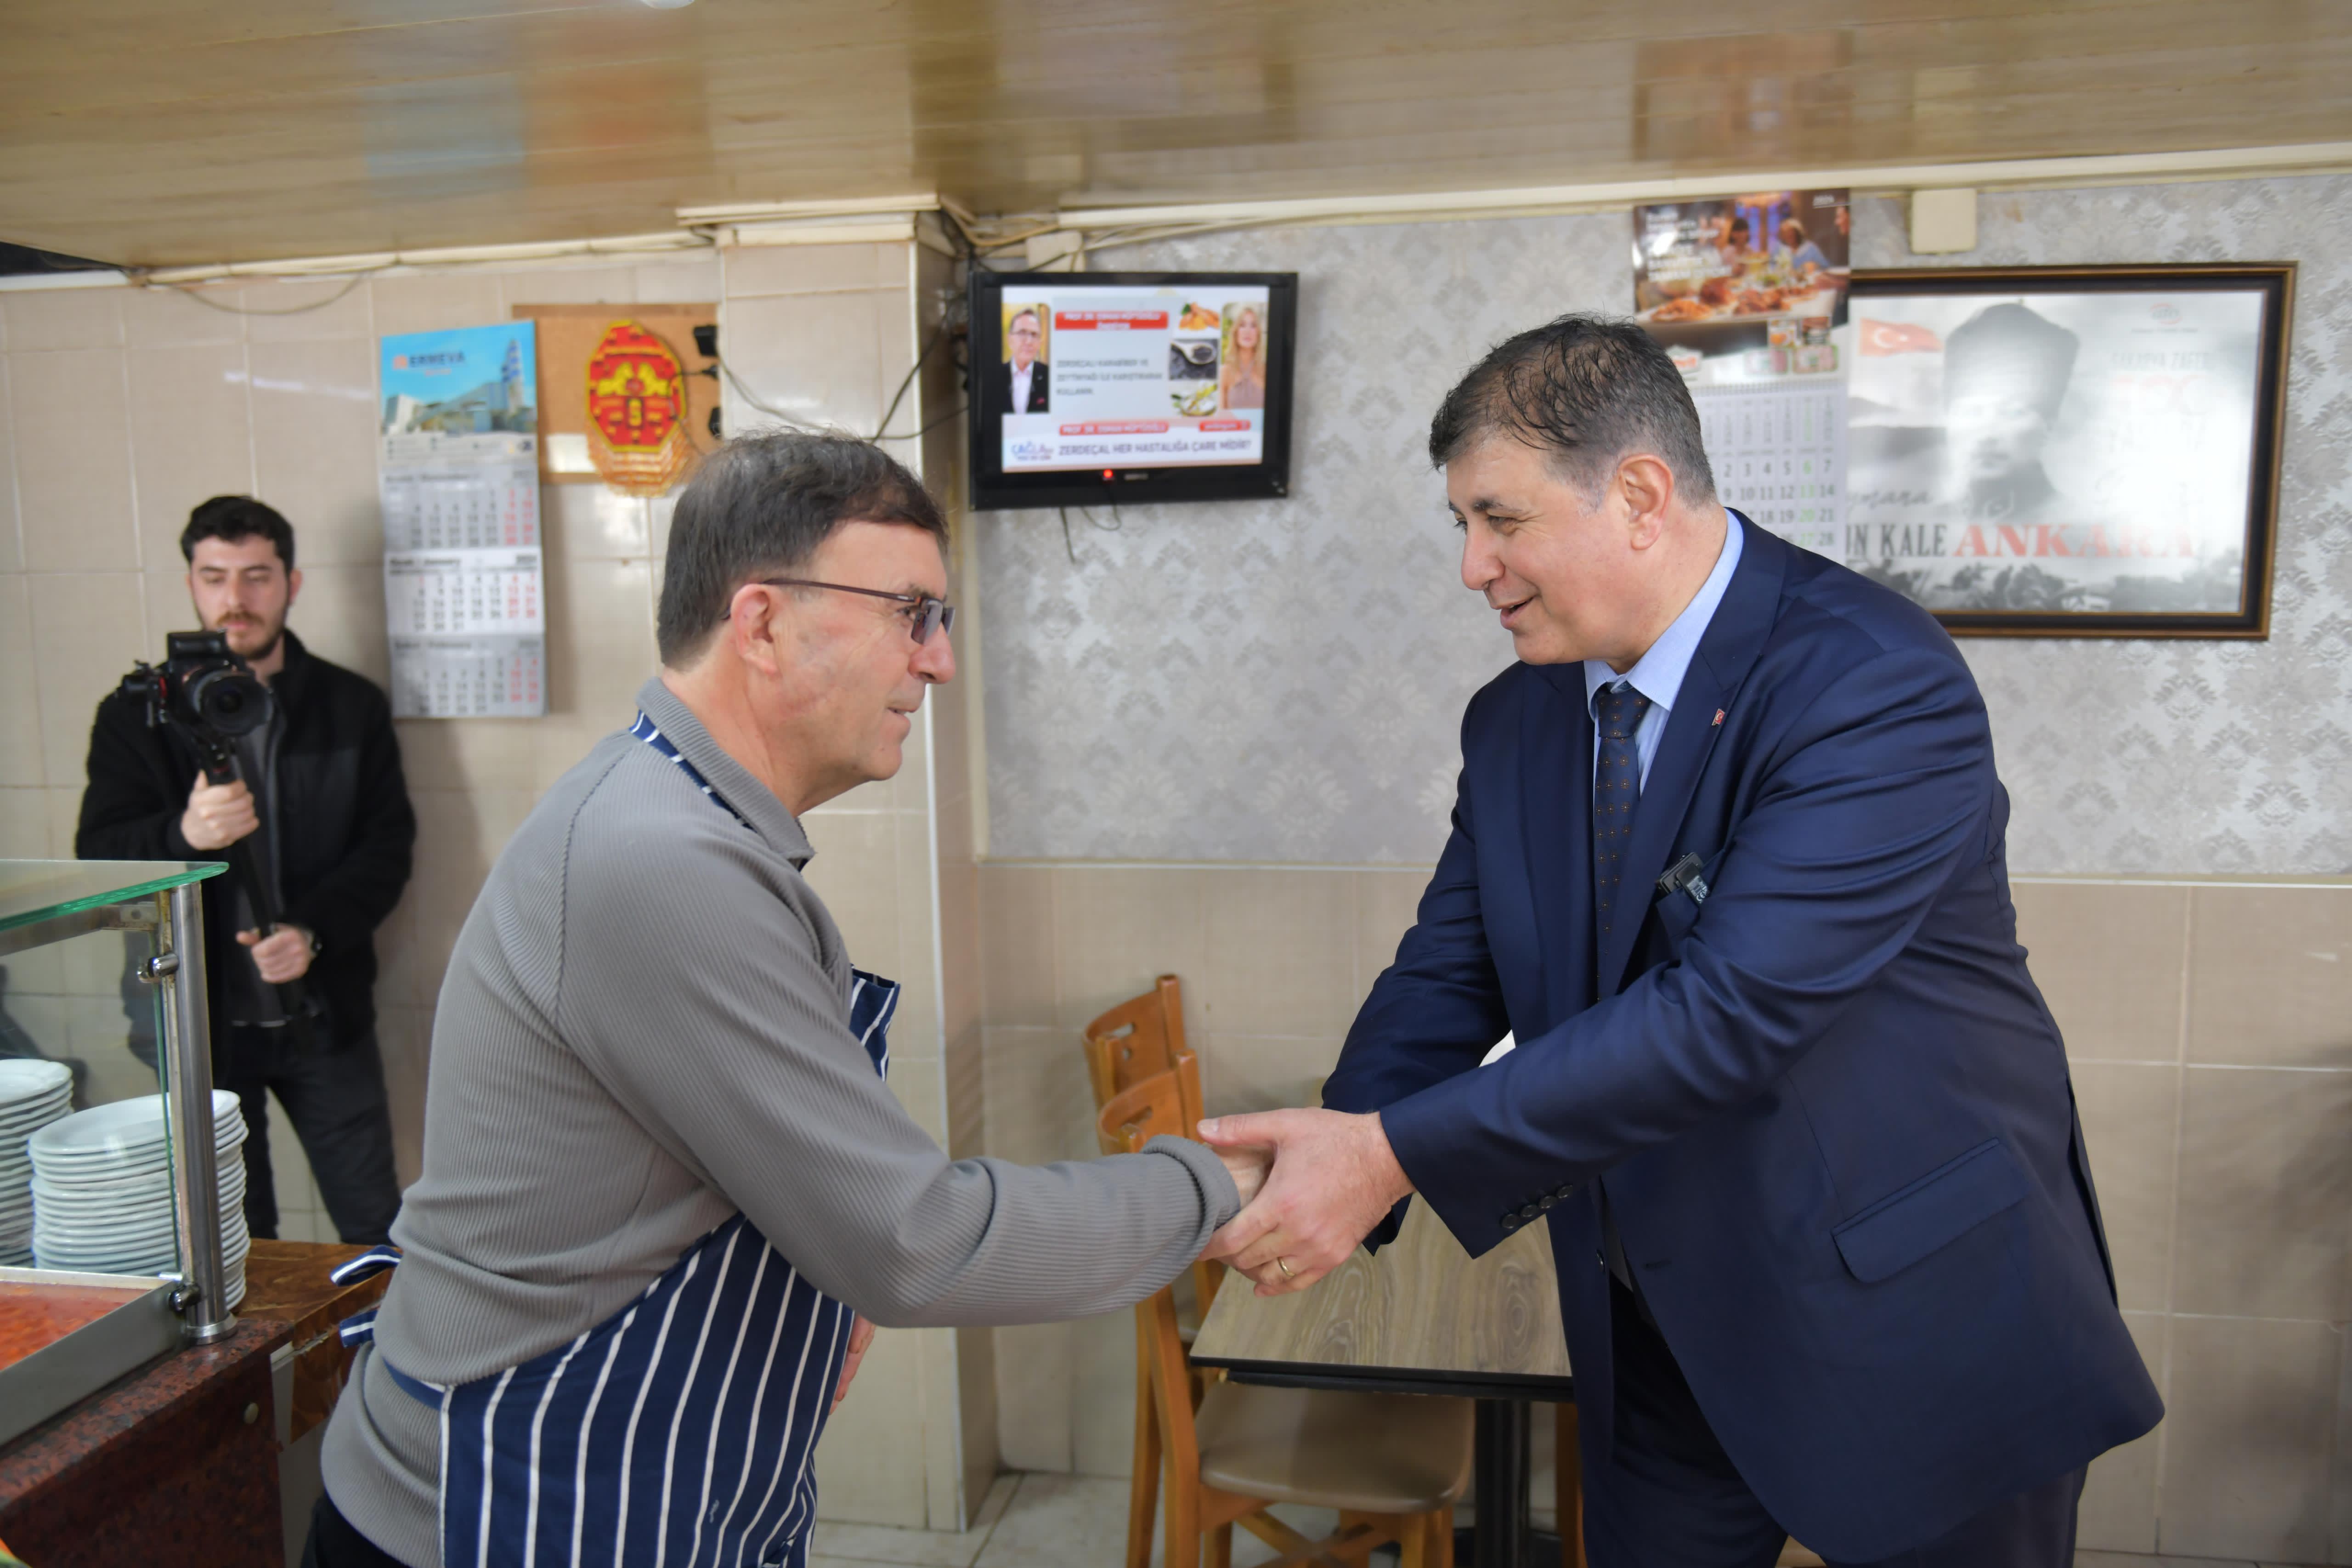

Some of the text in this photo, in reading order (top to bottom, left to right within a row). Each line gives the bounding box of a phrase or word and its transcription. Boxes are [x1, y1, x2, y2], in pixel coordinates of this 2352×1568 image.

[1058, 444, 1110, 457] ZERDEÇAL
[1114, 443, 1133, 454] HER
[1136, 439, 1188, 453] HASTALIĞA
[1192, 441, 1216, 453] ÇARE
[1724, 459, 1832, 478] 2 3 4 5 6 7
[1724, 487, 1732, 501] 9
[1740, 487, 1756, 501] 10
[1760, 486, 1773, 500] 11
[1781, 485, 1795, 499] 12
[1819, 484, 1835, 498] 14
[1760, 509, 1774, 524] 18
[1780, 509, 1794, 523] 19
[1819, 508, 1834, 522] 21
[1881, 524, 1947, 557] KALE
[1954, 524, 2194, 557] ANKARA
